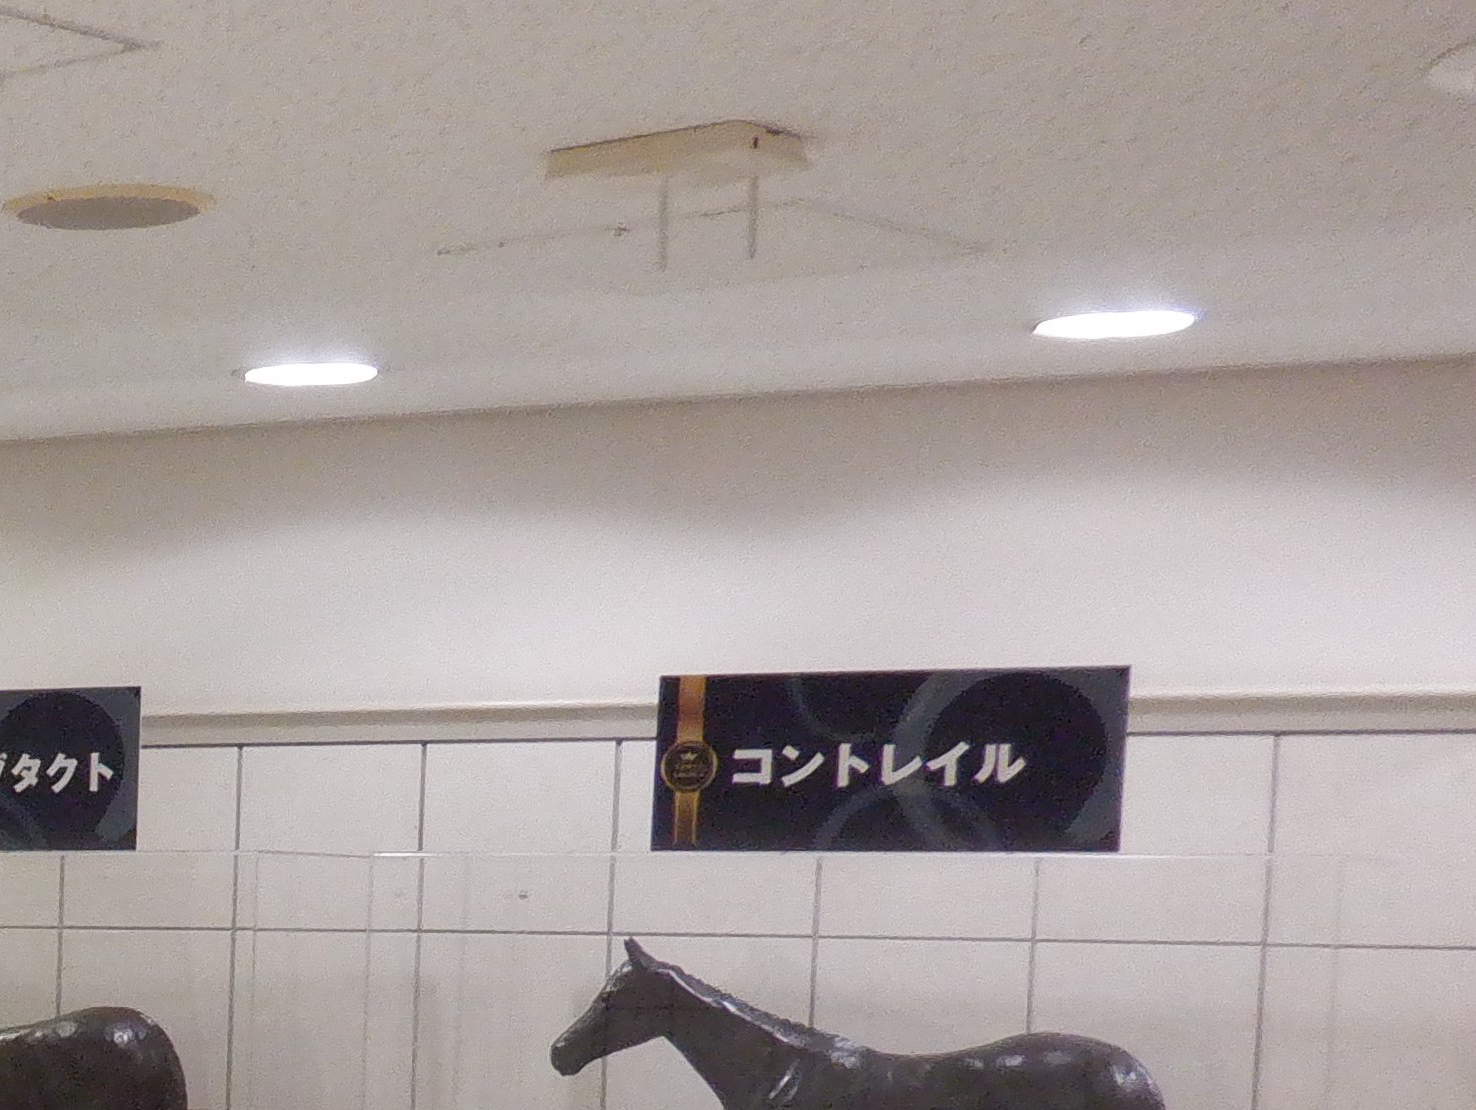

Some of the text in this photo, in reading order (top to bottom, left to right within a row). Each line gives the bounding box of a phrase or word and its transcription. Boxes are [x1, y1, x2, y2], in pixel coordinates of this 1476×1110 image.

[731, 741, 1027, 787] コントレイル
